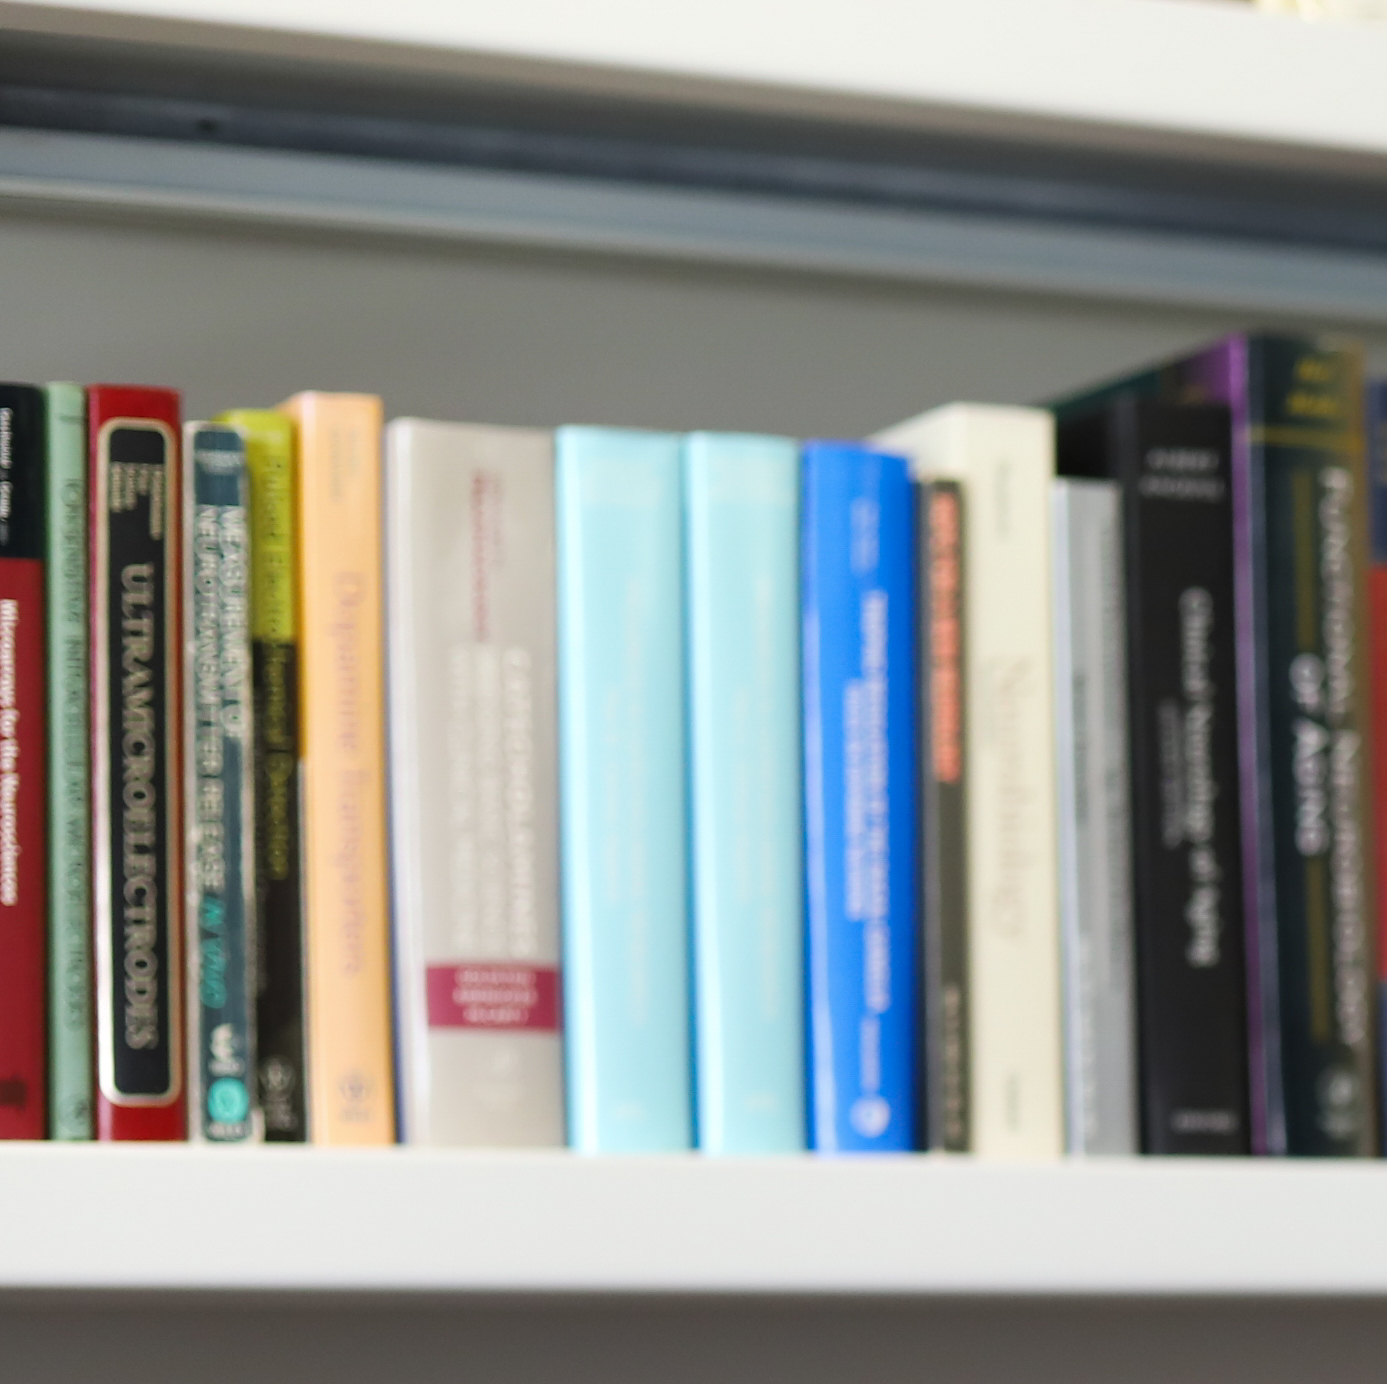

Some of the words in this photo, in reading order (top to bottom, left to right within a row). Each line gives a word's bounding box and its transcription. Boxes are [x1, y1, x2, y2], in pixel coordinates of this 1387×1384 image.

[195, 505, 224, 775] NEUROTRANSMITTER
[219, 506, 247, 702] MEASUREMENT
[331, 572, 367, 755] Dopamine
[121, 562, 157, 1050] ULTRAMICROELECTRODES
[199, 779, 225, 894] RELEASE
[333, 768, 370, 977] Transporters
